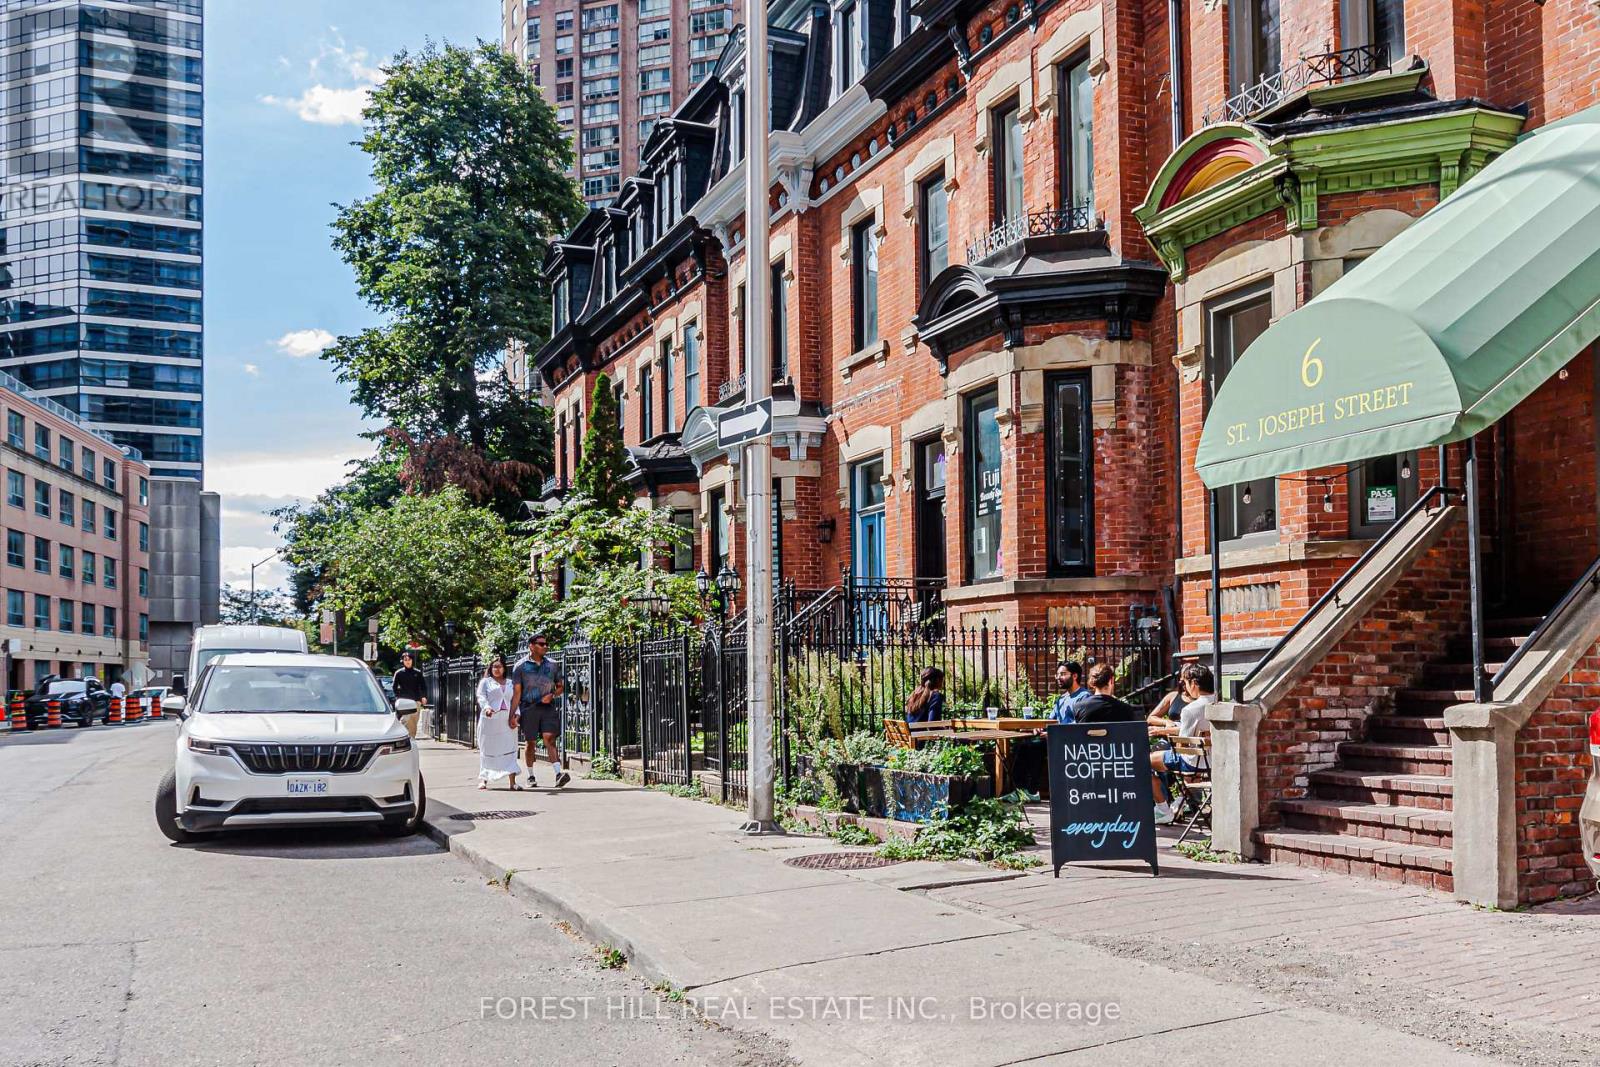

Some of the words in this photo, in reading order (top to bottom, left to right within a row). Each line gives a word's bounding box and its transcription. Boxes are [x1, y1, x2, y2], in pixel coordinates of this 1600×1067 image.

[1301, 337, 1326, 388] 6
[1226, 423, 1250, 446] ST.
[1258, 402, 1325, 442] JOSEPH
[1334, 382, 1413, 420] STREET
[1370, 489, 1393, 498] PASS
[1064, 743, 1134, 761] NABULU
[1064, 761, 1135, 779] COFFEE
[1069, 788, 1080, 805] 8
[1061, 814, 1141, 849] everyday
